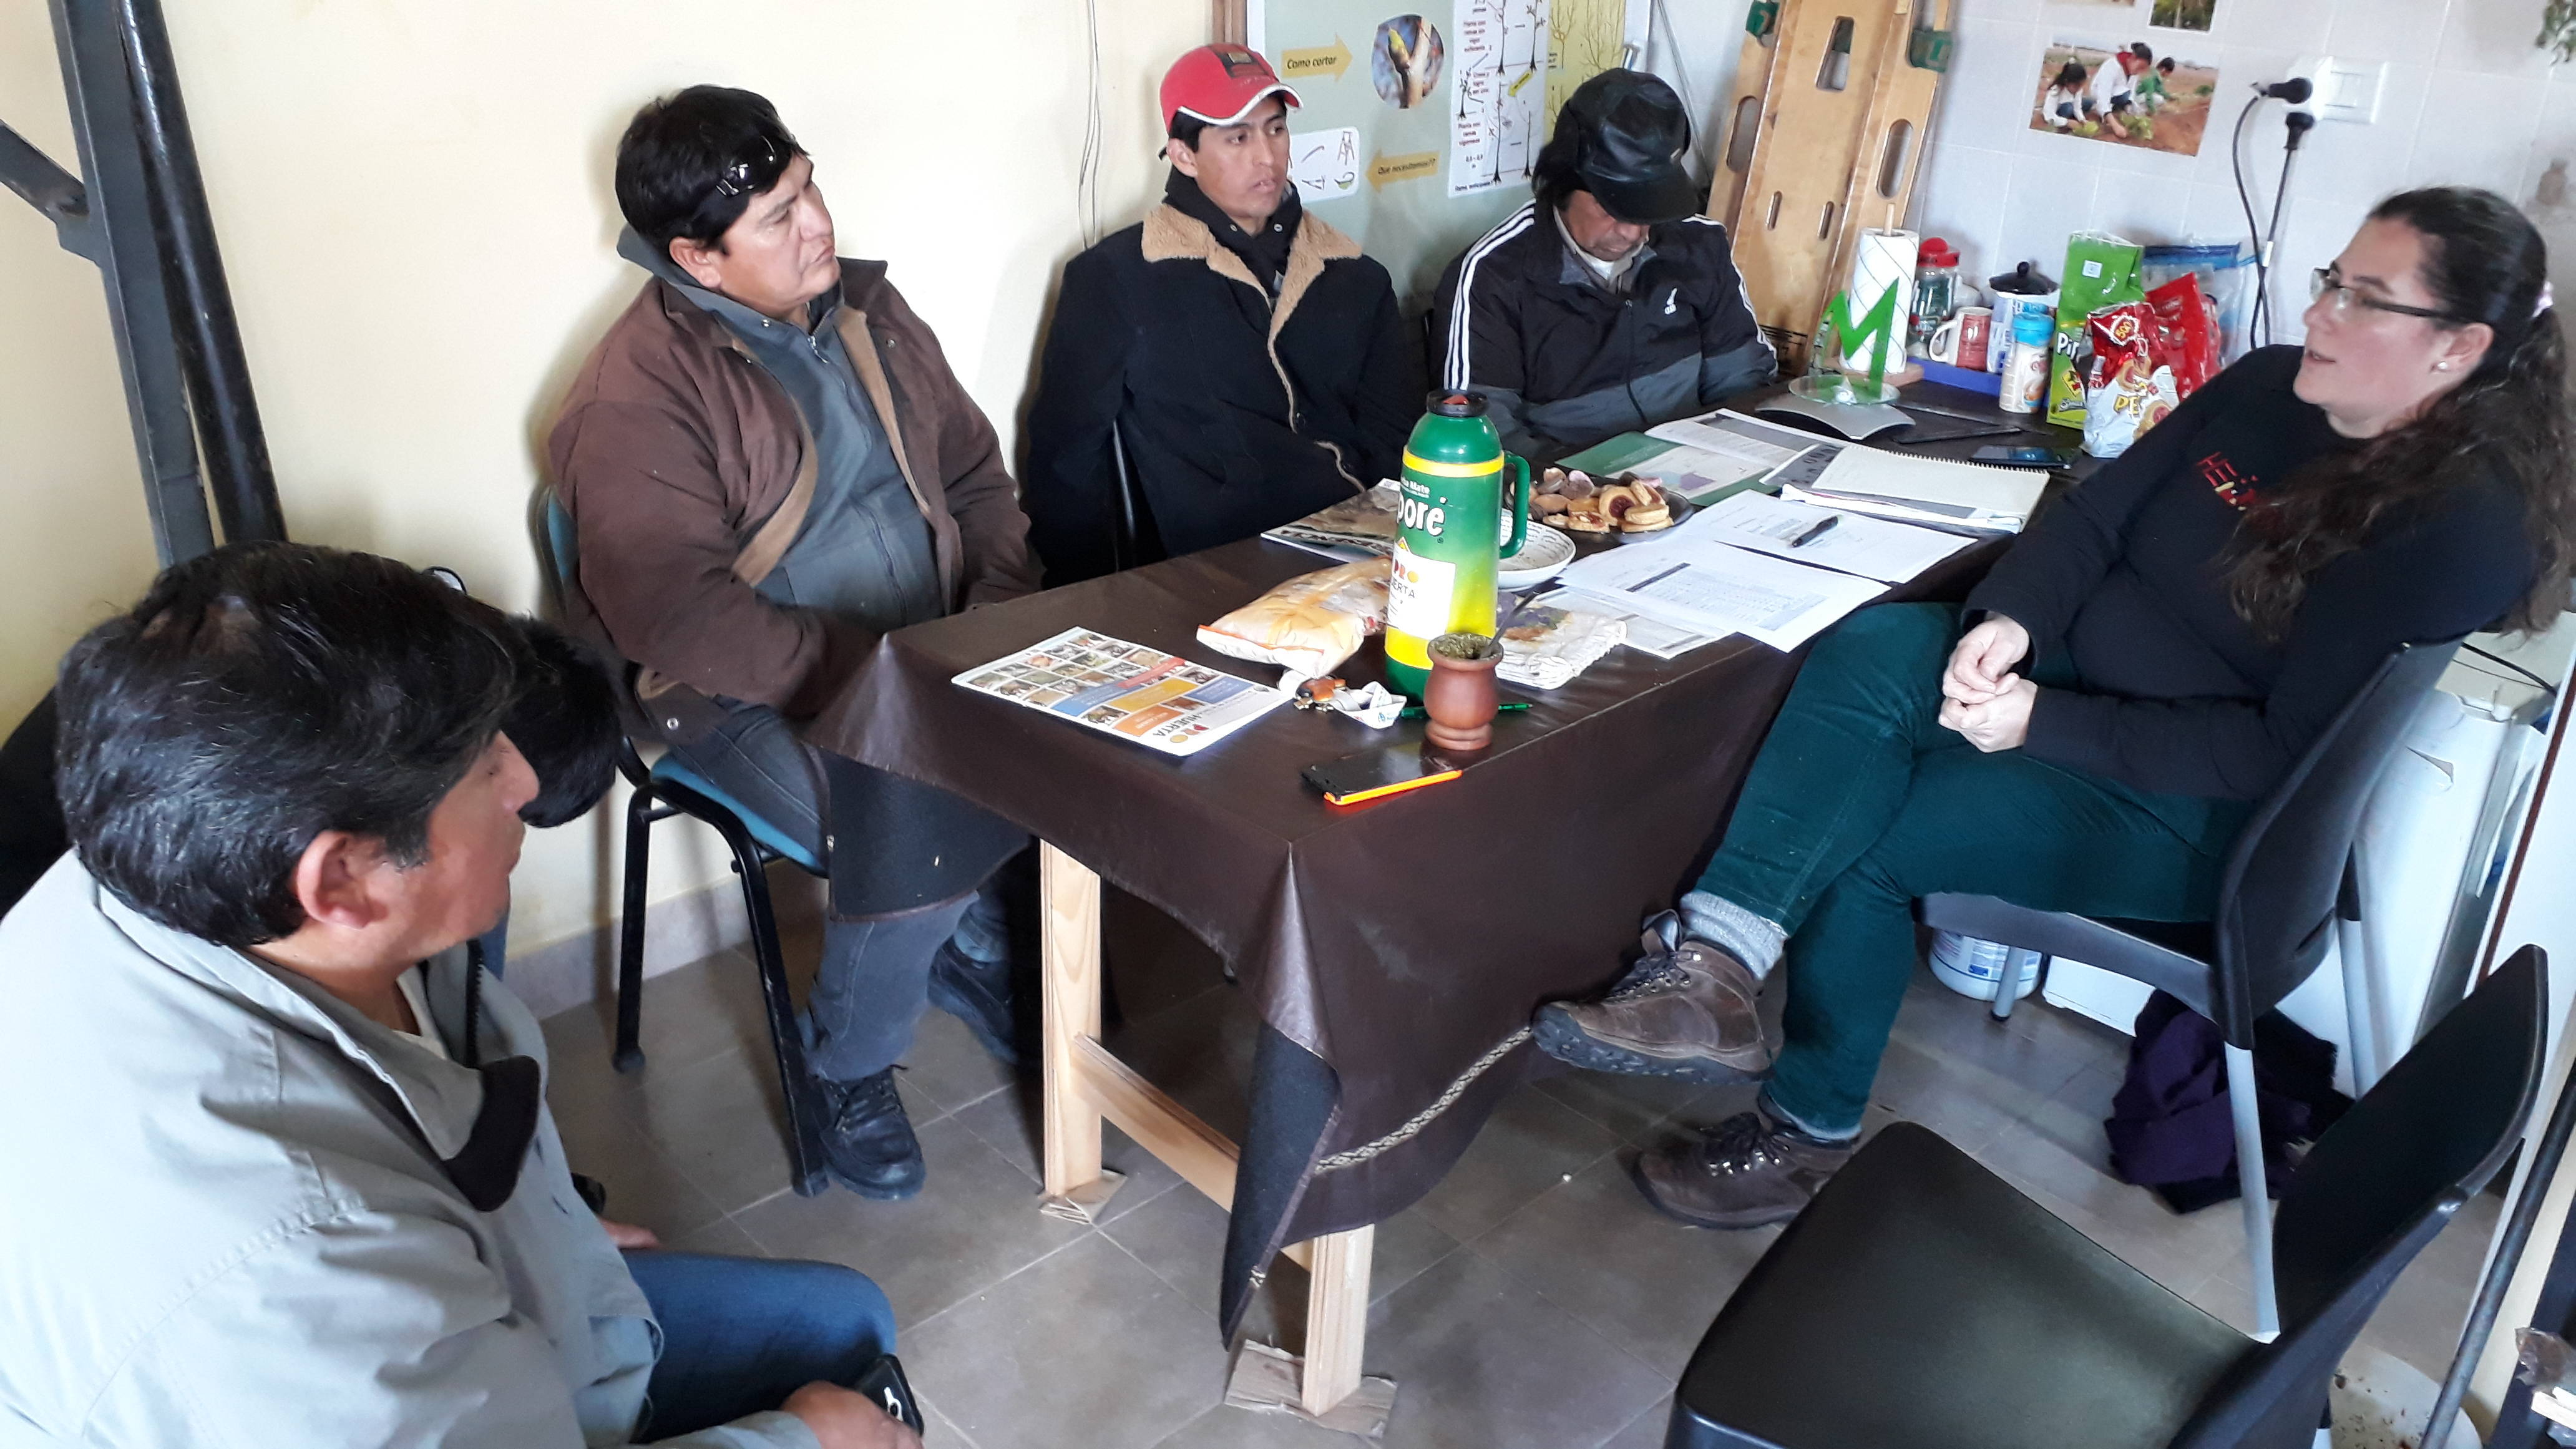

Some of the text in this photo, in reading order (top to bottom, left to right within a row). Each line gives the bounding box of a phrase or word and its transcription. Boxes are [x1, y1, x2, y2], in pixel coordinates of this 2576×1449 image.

[1287, 56, 1337, 69] Como cortar
[1410, 480, 1430, 494] Mate
[1397, 497, 1448, 537] poré
